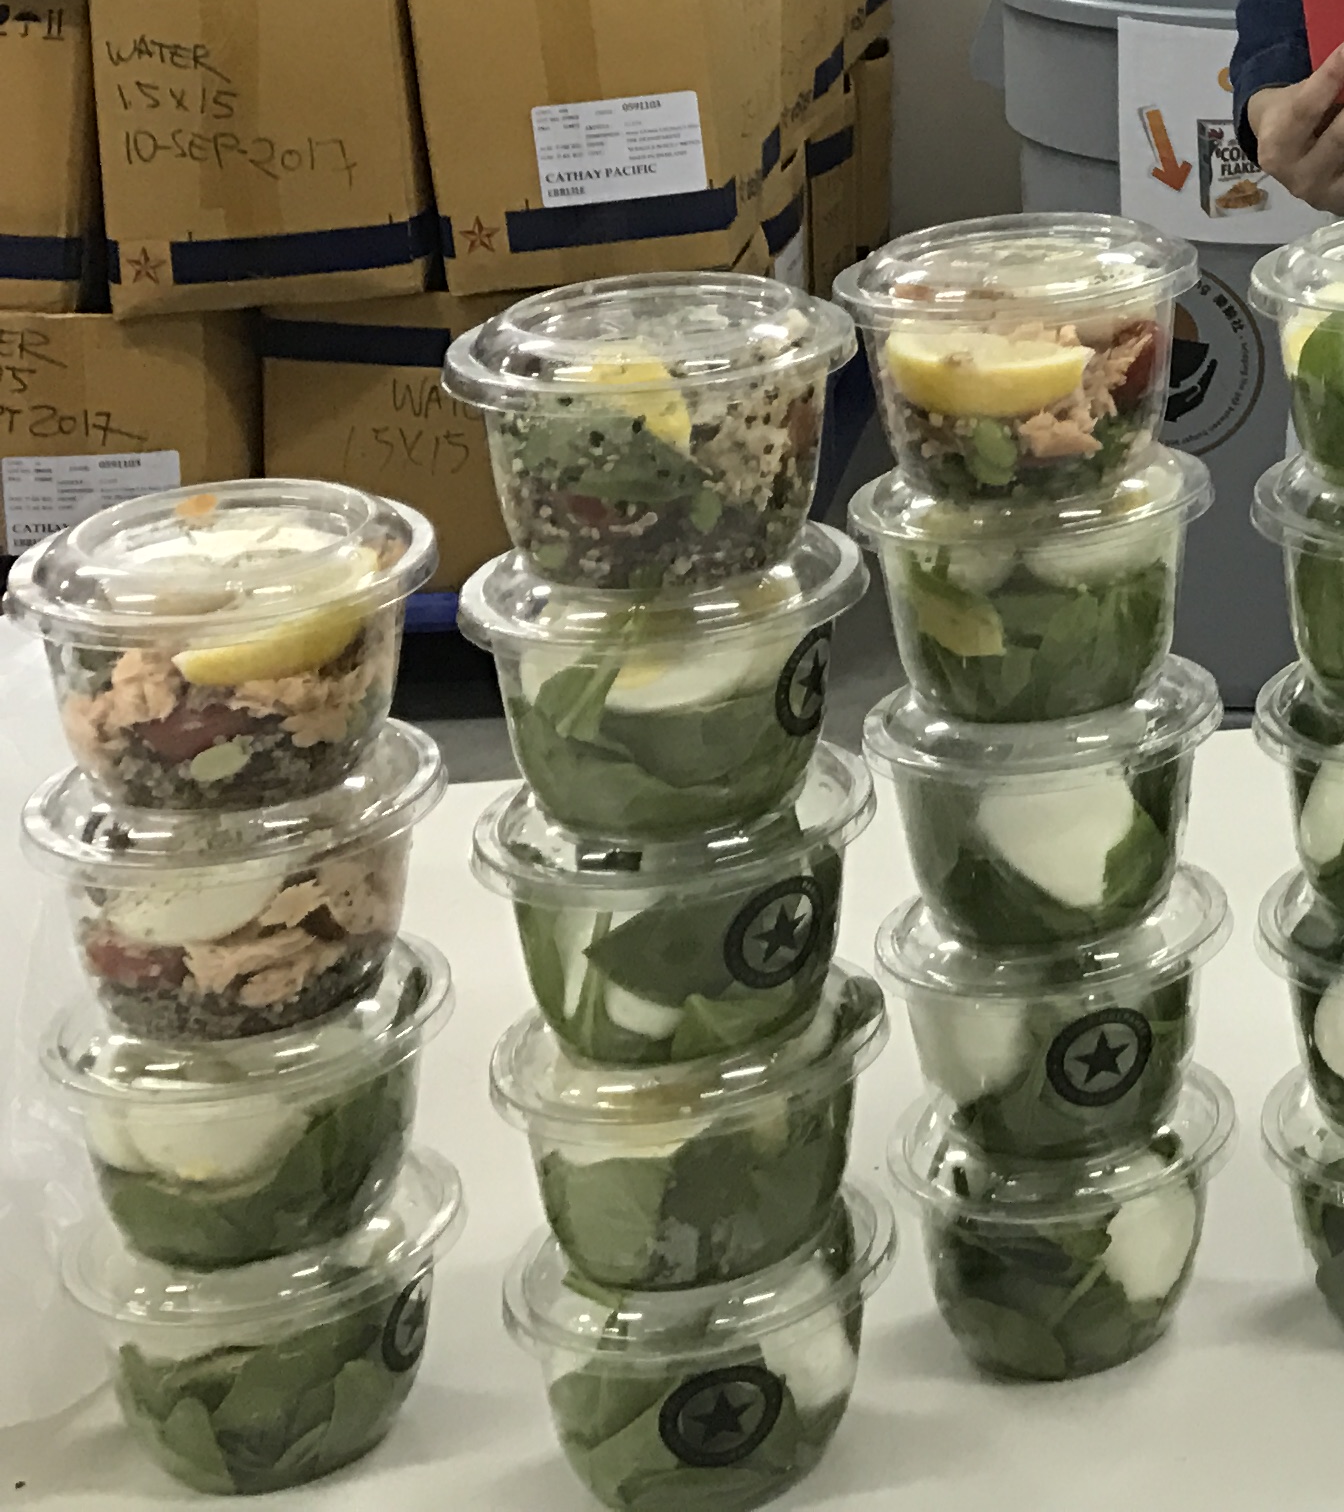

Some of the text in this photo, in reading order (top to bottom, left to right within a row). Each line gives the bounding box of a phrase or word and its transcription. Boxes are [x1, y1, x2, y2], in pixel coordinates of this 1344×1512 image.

[105, 34, 231, 83] WATER
[545, 162, 657, 184] CATHAY PACIFIC
